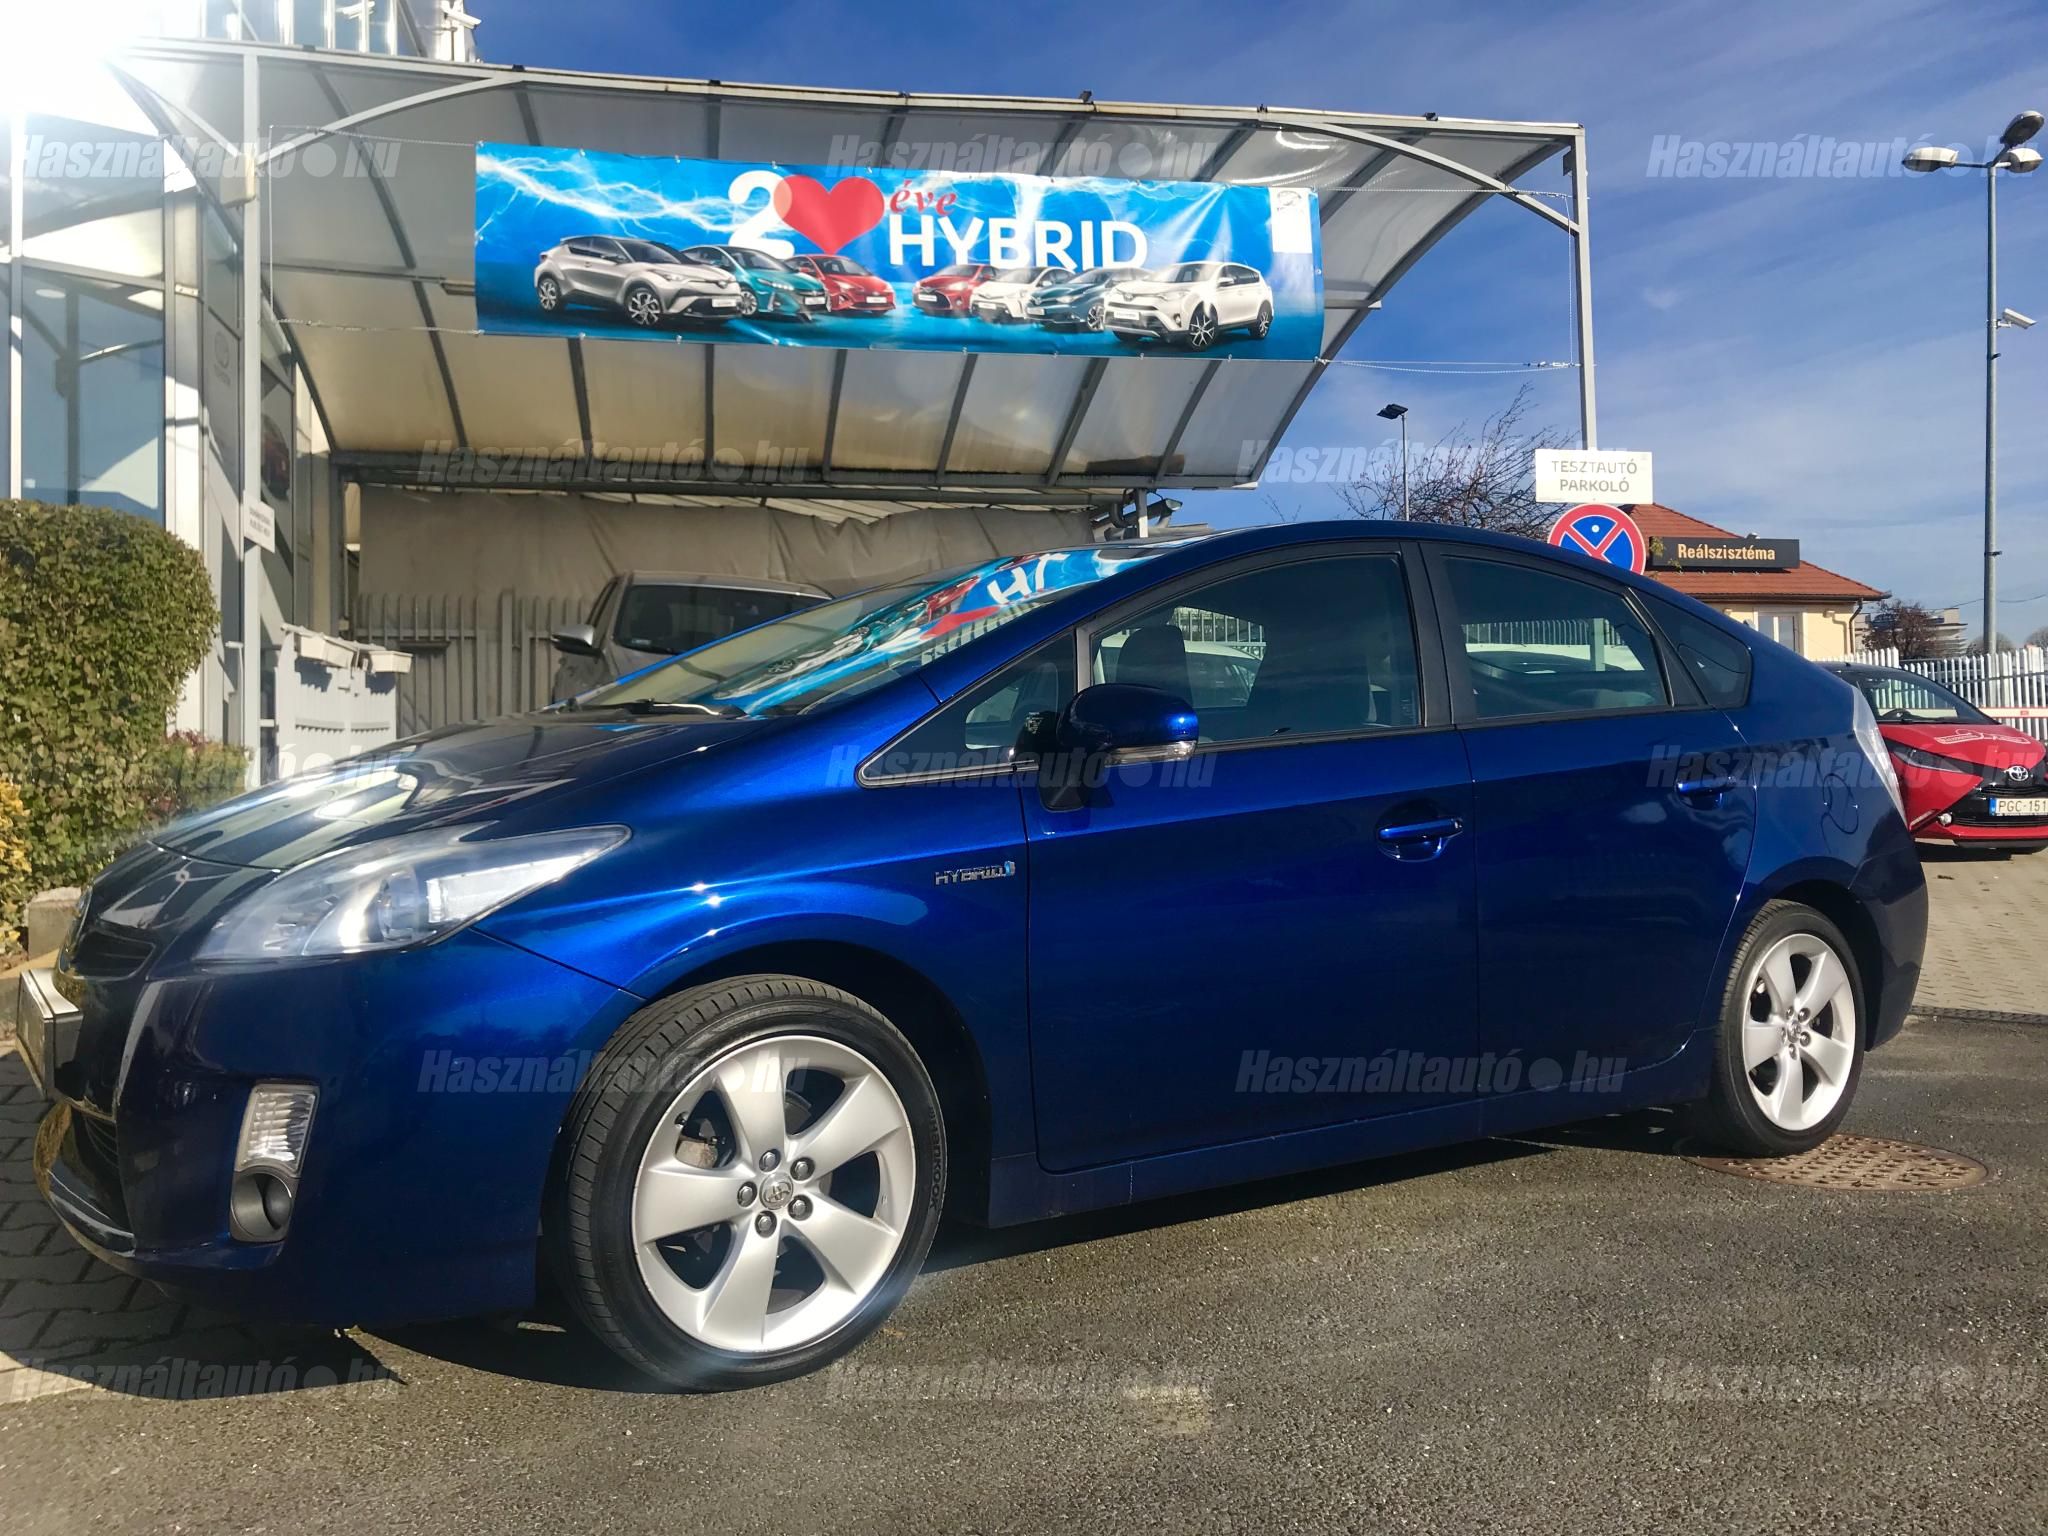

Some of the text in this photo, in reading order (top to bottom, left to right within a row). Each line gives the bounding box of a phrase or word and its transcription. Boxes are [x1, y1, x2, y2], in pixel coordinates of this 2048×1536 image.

[890, 180, 957, 216] éve
[889, 213, 1148, 273] HYBRID
[1552, 459, 1637, 474] TESZTAUTÓ
[1560, 477, 1630, 492] PARKOLÓ
[1678, 543, 1775, 560] Reálszisztéma
[935, 865, 1006, 885] HYBRID
